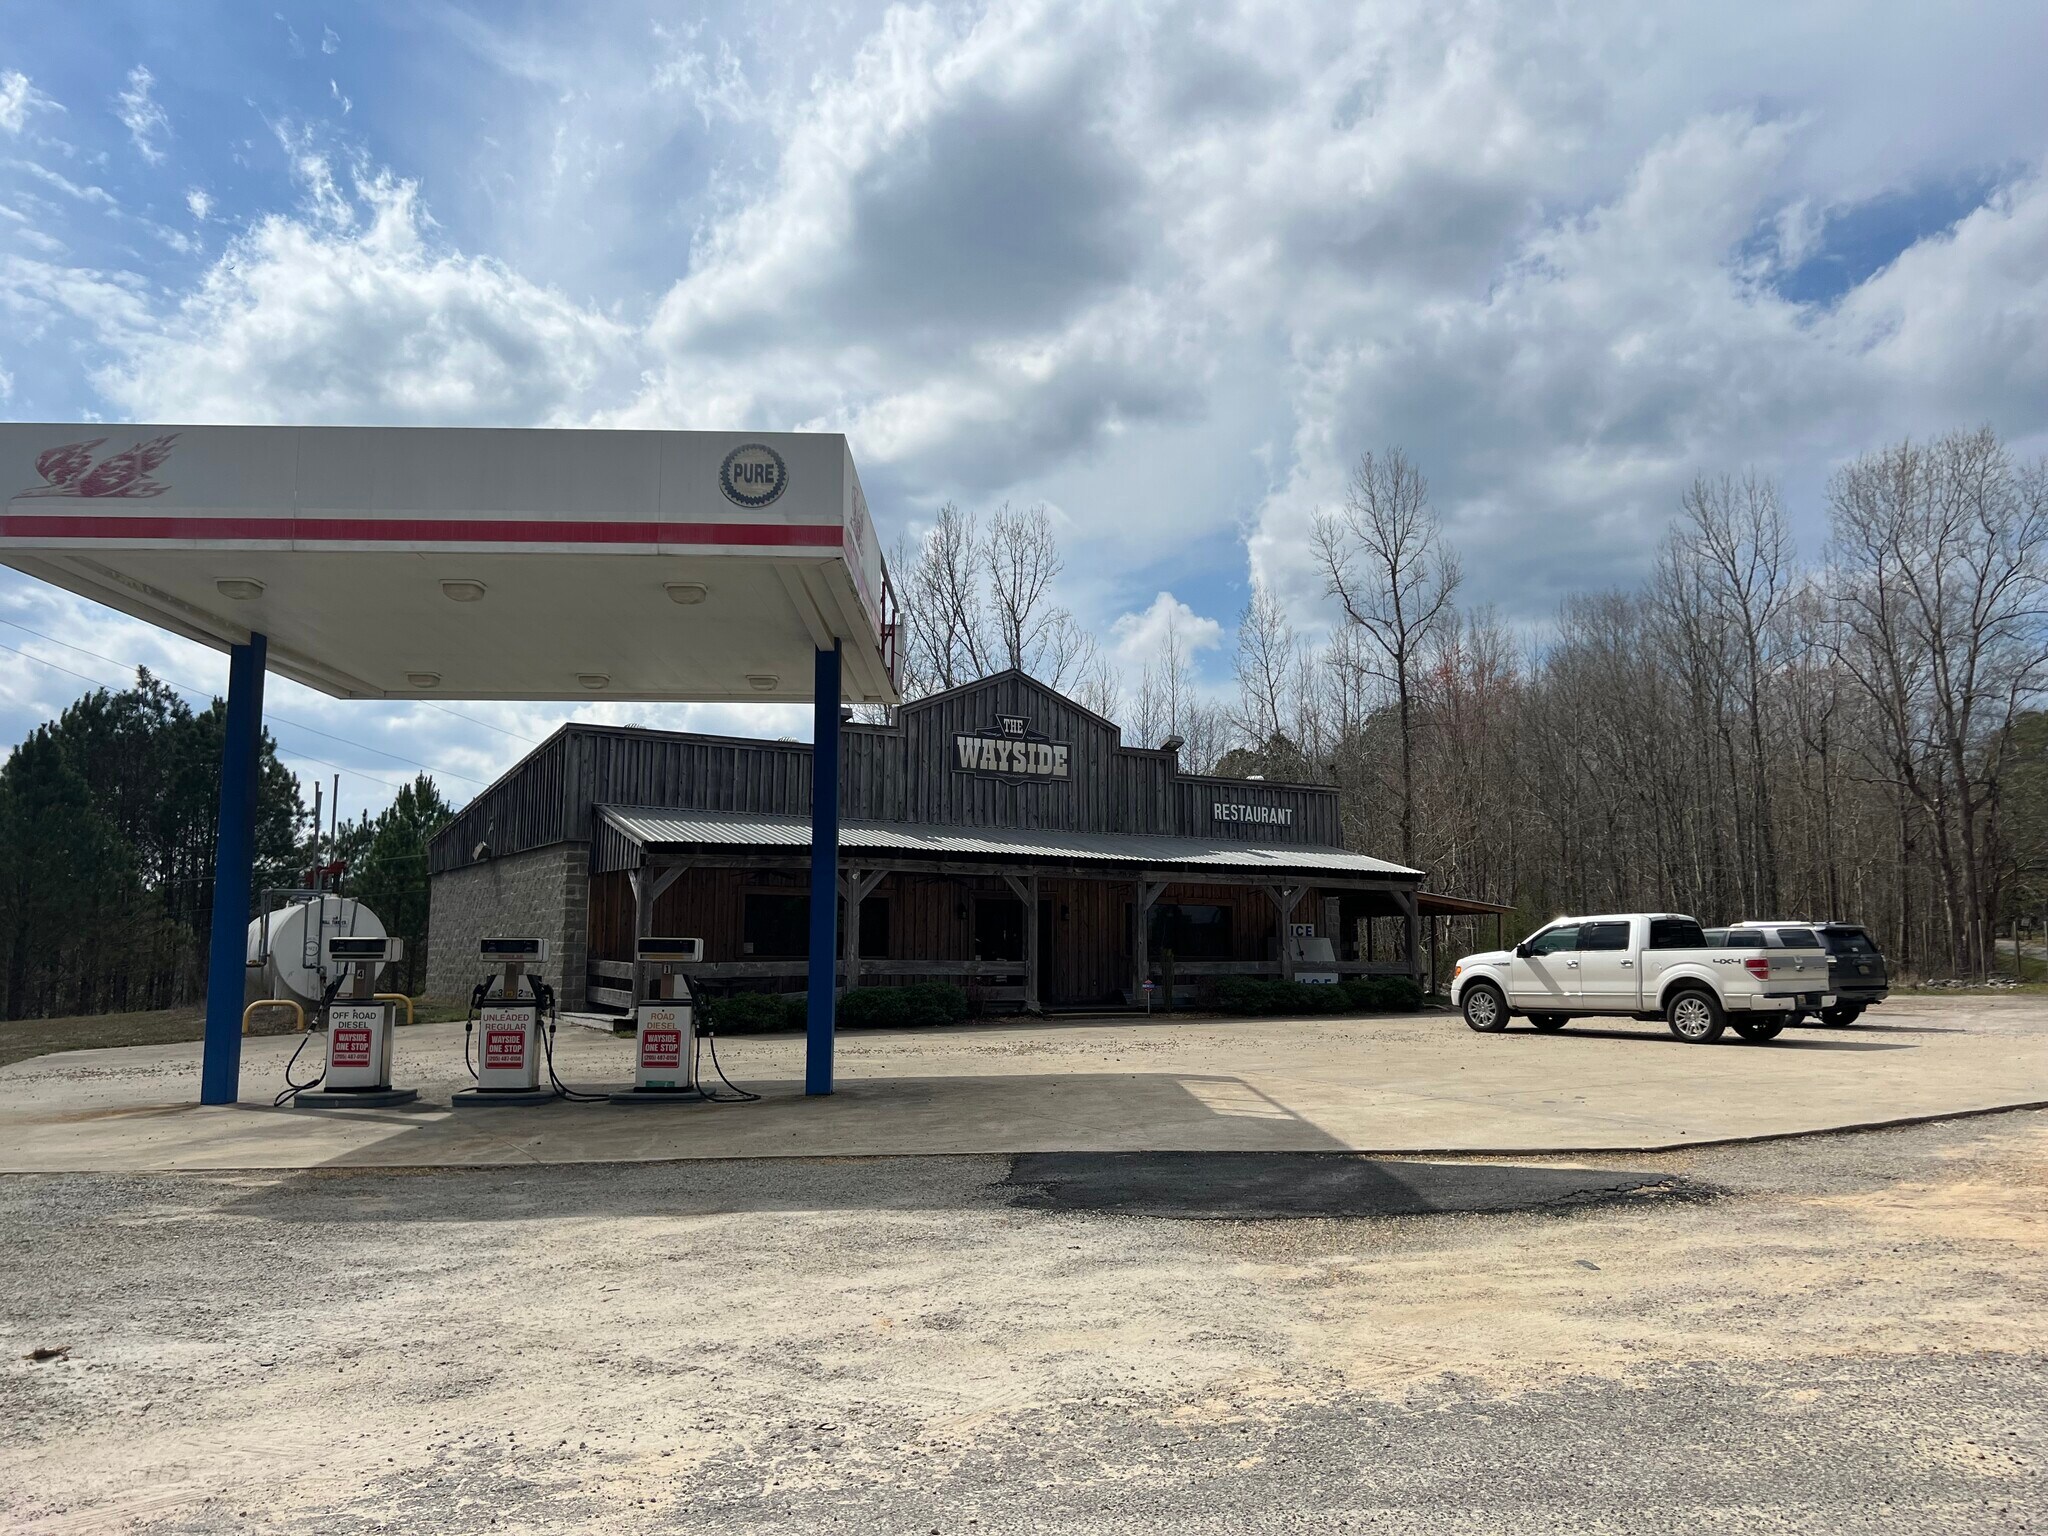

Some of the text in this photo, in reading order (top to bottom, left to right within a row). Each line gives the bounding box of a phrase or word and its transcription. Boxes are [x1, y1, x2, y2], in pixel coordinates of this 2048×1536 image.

[734, 463, 774, 483] PURE
[1003, 718, 1023, 734] THE
[957, 736, 1068, 777] WAYSIDE
[1213, 803, 1292, 825] RESTAURANT
[1290, 925, 1312, 937] ICE
[357, 970, 363, 978] 4
[498, 989, 503, 997] 3
[518, 989, 524, 997] 2
[332, 1011, 377, 1020] OFF ROAD
[483, 1013, 530, 1021] UNLEADED
[650, 1012, 675, 1020] ROAD
[338, 1021, 369, 1029] DIESEL
[485, 1023, 527, 1031] REGULAR
[647, 1022, 678, 1030] DIESEL
[338, 1033, 368, 1042] WAYSIDE
[491, 1035, 521, 1044] WAYSIDE
[647, 1034, 677, 1043] WAYSIDE
[336, 1042, 369, 1051] ONE STOP
[489, 1044, 522, 1053] ONE STOP
[645, 1043, 678, 1052] ONE STOP
